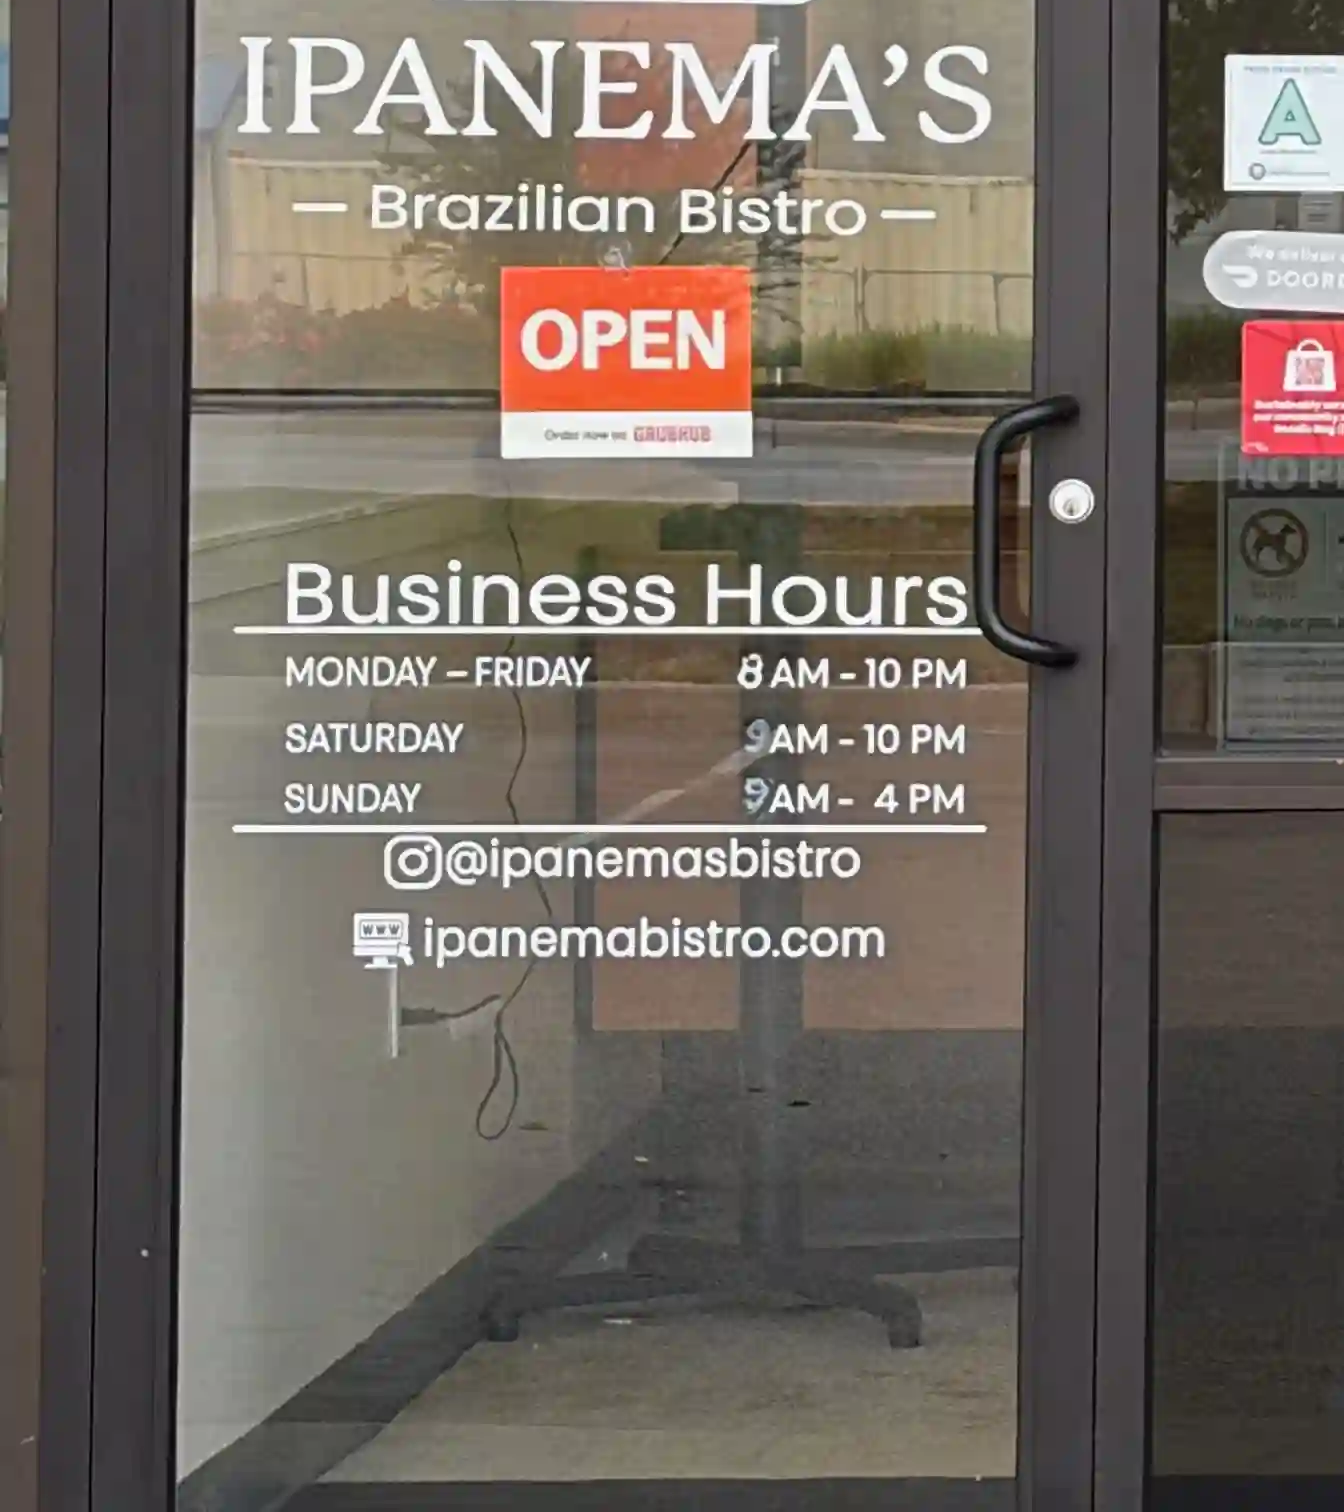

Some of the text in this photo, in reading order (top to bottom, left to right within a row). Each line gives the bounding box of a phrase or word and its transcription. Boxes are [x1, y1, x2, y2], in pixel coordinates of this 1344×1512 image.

[238, 37, 991, 143] IPANEMA'S
[1258, 77, 1322, 145] A
[372, 184, 866, 235] Brazilian Bistro
[522, 310, 724, 370] OPEN
[633, 424, 712, 443] GRUBHUB
[1238, 452, 1298, 491] NO
[282, 560, 967, 627] Business Hours
[286, 657, 437, 687] MONDAY
[476, 657, 590, 687] FRIDAY
[771, 658, 828, 688] AM
[865, 659, 900, 688] 10
[913, 659, 965, 688] PM
[286, 723, 463, 753] SATURDAY
[864, 724, 899, 753] 10
[912, 724, 964, 754] PM
[284, 784, 420, 813] SUNDAY
[874, 784, 898, 813] 4
[910, 784, 964, 813] PM
[446, 838, 860, 888] @ipanemasbistro
[425, 917, 884, 968] ipanemabistro.com
